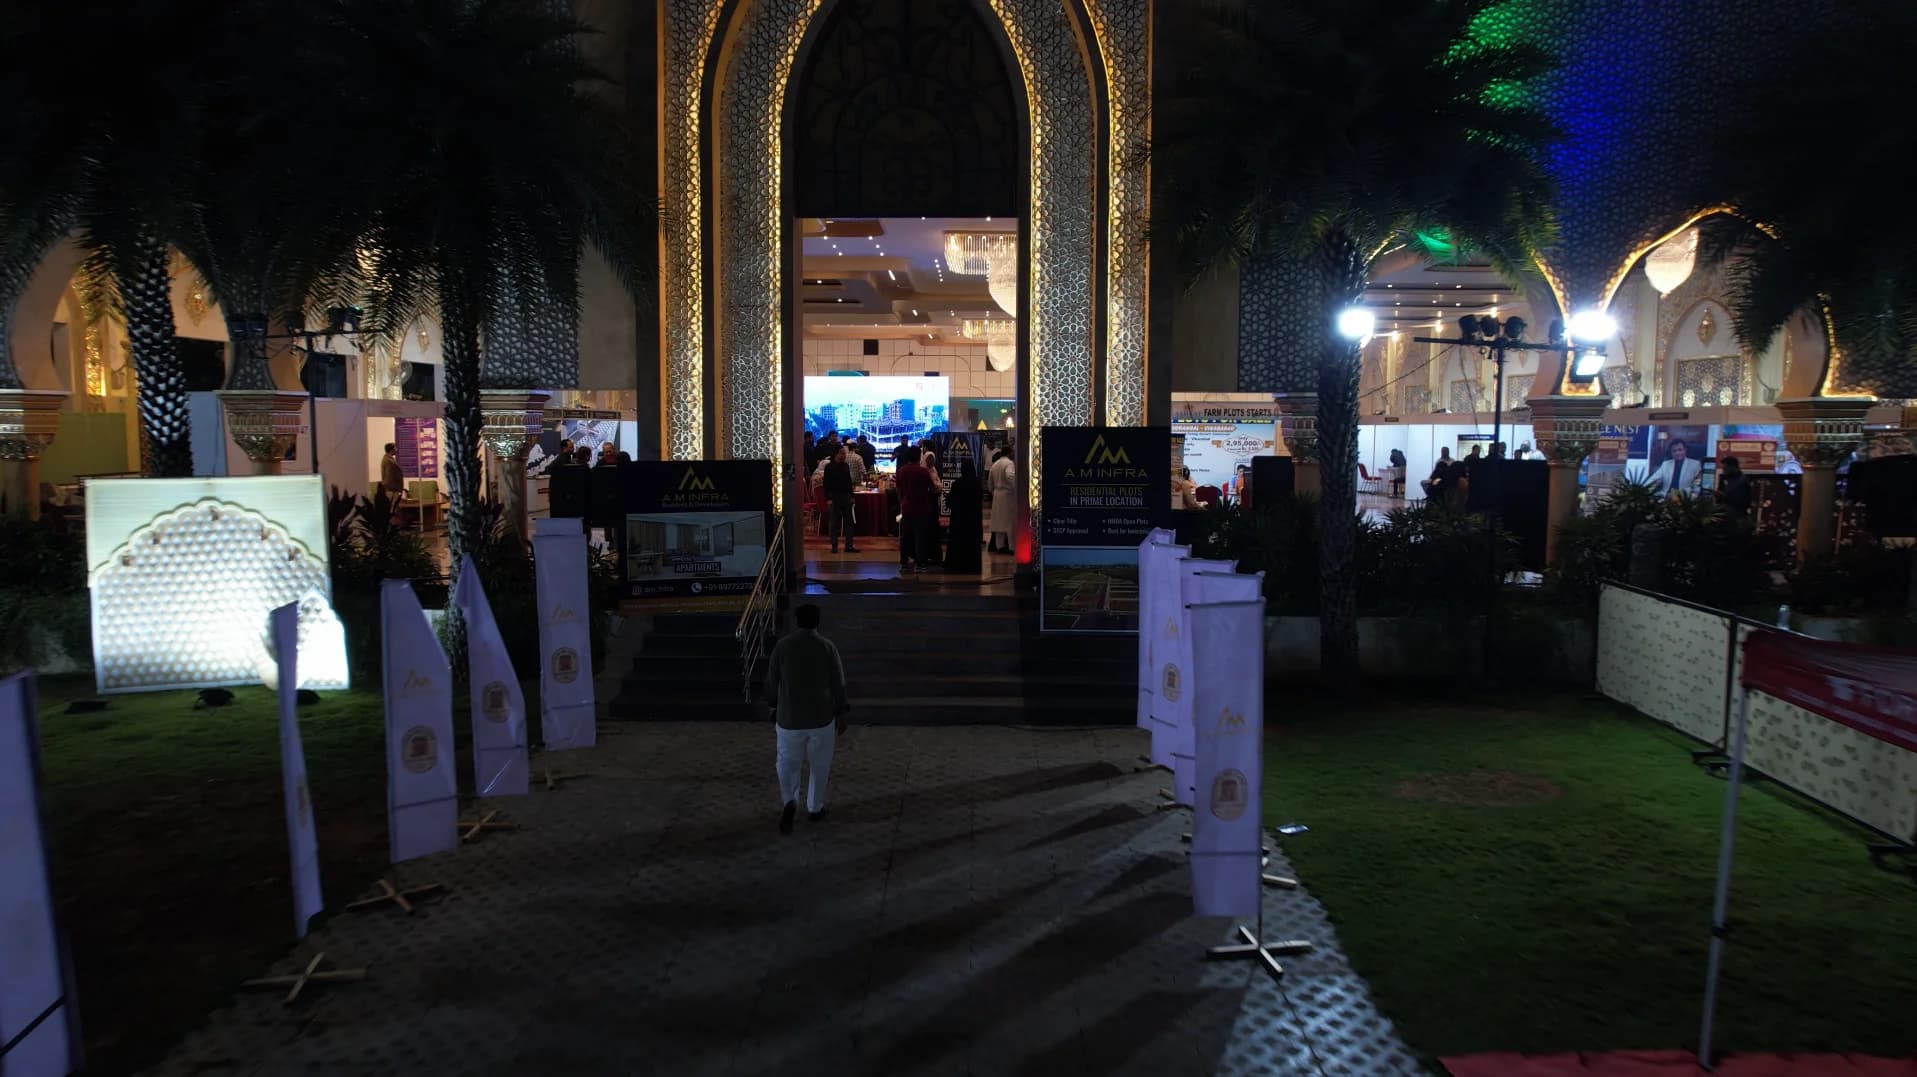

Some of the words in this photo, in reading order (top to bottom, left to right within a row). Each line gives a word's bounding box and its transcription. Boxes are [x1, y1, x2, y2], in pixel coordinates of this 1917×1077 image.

[1204, 408, 1221, 416] FARM
[1223, 408, 1245, 416] PLOTS
[1097, 468, 1148, 478] INFRA
[1070, 487, 1117, 496] RESIDENTIAL
[1119, 487, 1143, 496] PLOTS
[1070, 497, 1078, 506] IN
[1080, 497, 1104, 506] PRIME
[1106, 497, 1143, 506] LOCATION
[676, 563, 720, 573] APARTMENTS
